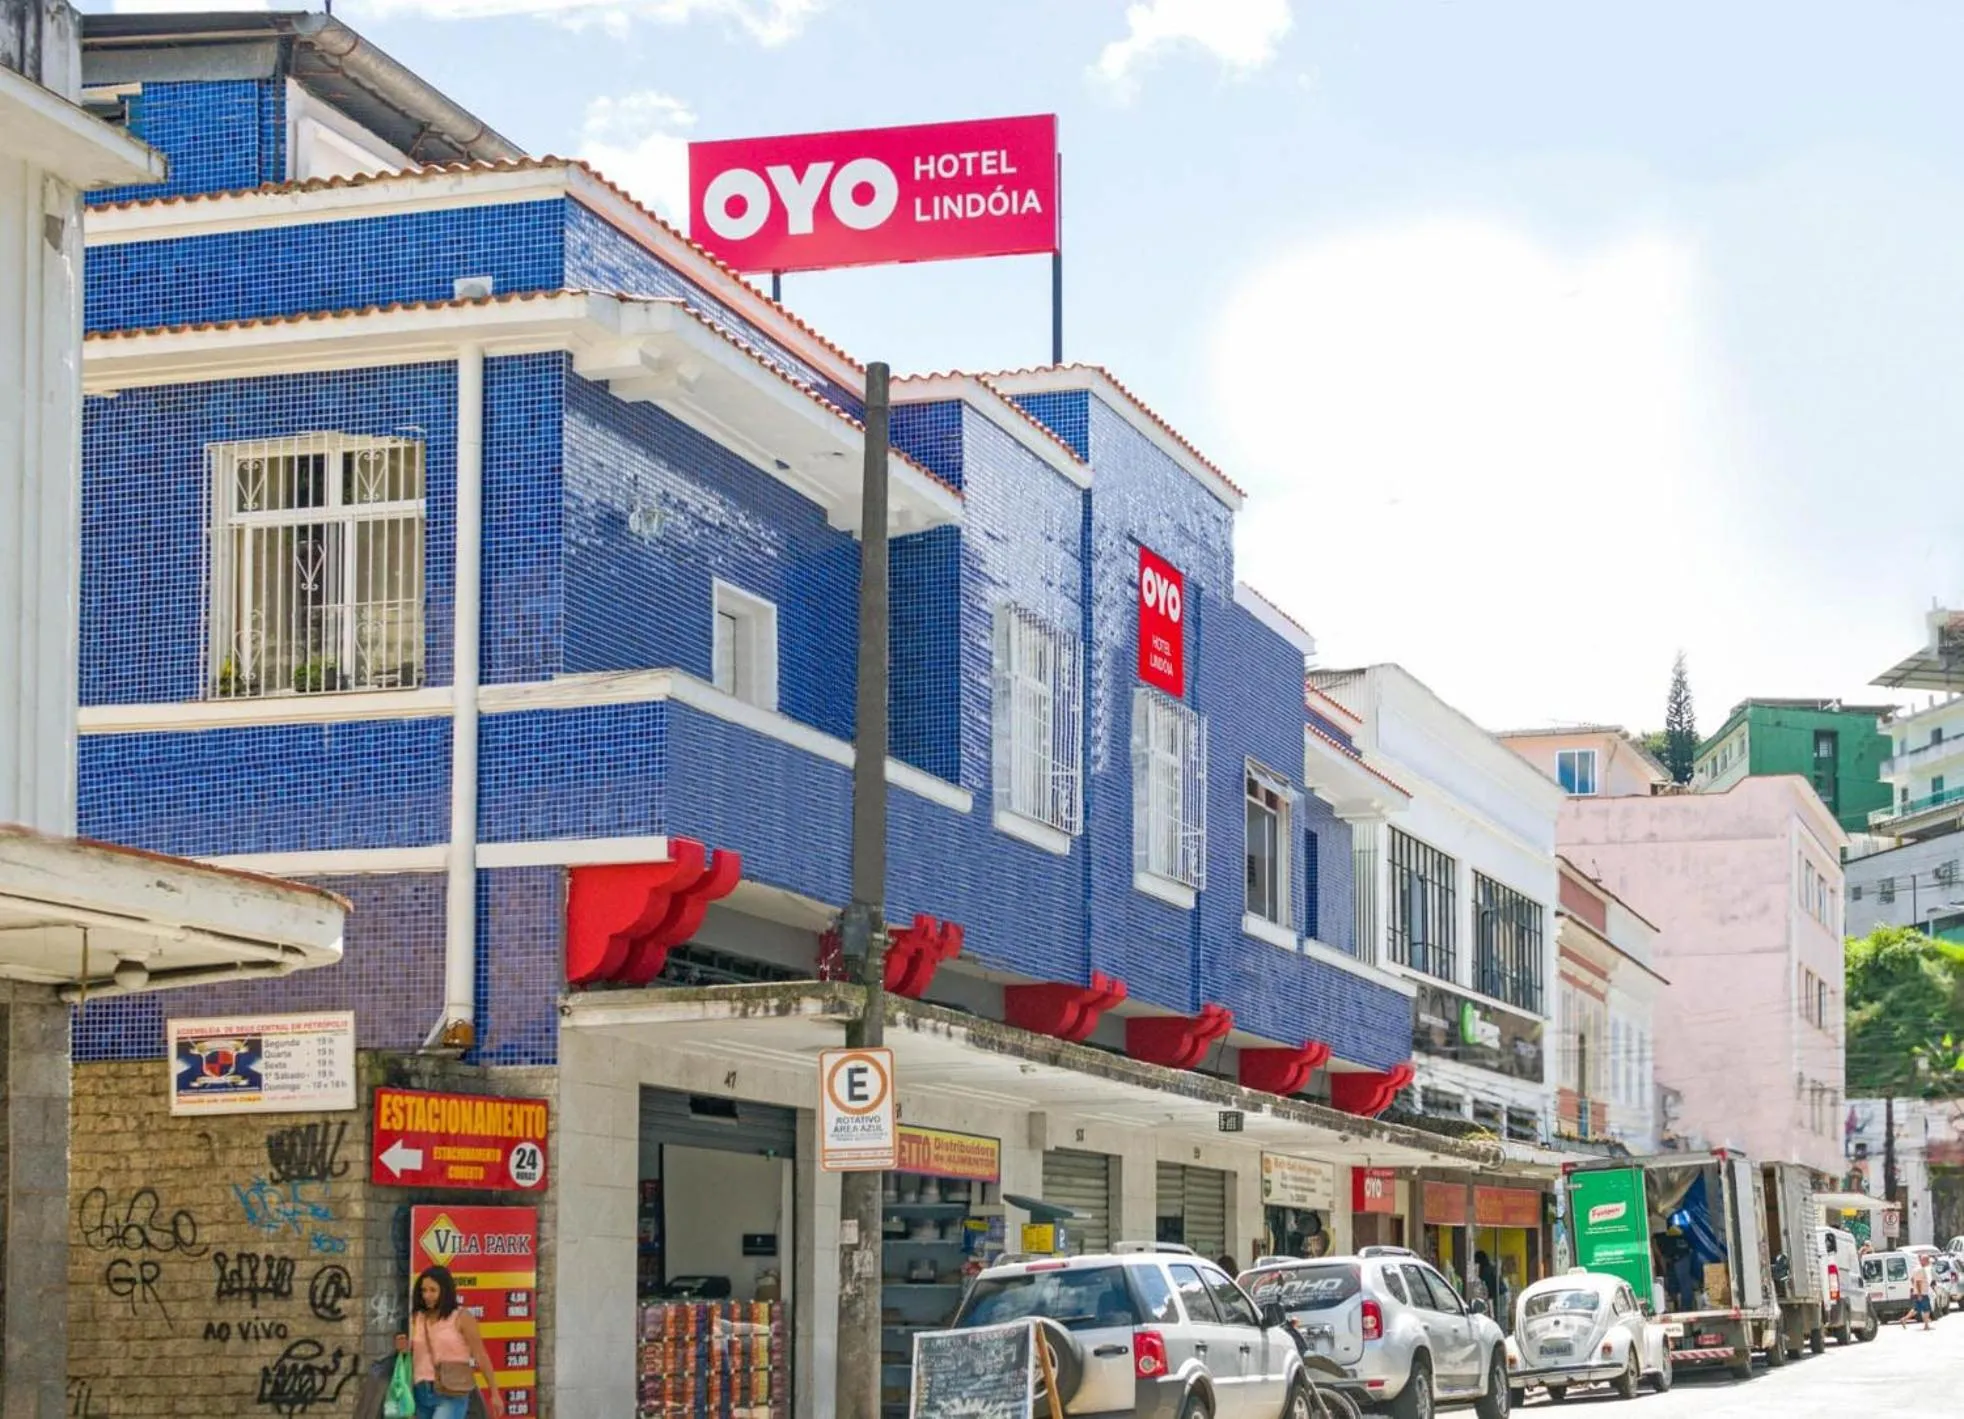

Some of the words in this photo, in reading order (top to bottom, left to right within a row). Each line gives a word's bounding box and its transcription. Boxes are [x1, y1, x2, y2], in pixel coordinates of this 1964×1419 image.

[914, 149, 1017, 181] HOTEL
[703, 157, 899, 241] OYO
[914, 186, 1042, 222] LINDÓIA
[1142, 567, 1181, 623] OYO
[1152, 633, 1172, 656] HOTEL
[848, 1067, 869, 1101] E
[380, 1093, 547, 1138] ESTACIONAMENTO
[515, 1147, 538, 1170] 24
[1364, 1177, 1382, 1199] OYO
[485, 1235, 530, 1254] PARK
[203, 1321, 231, 1343] AO
